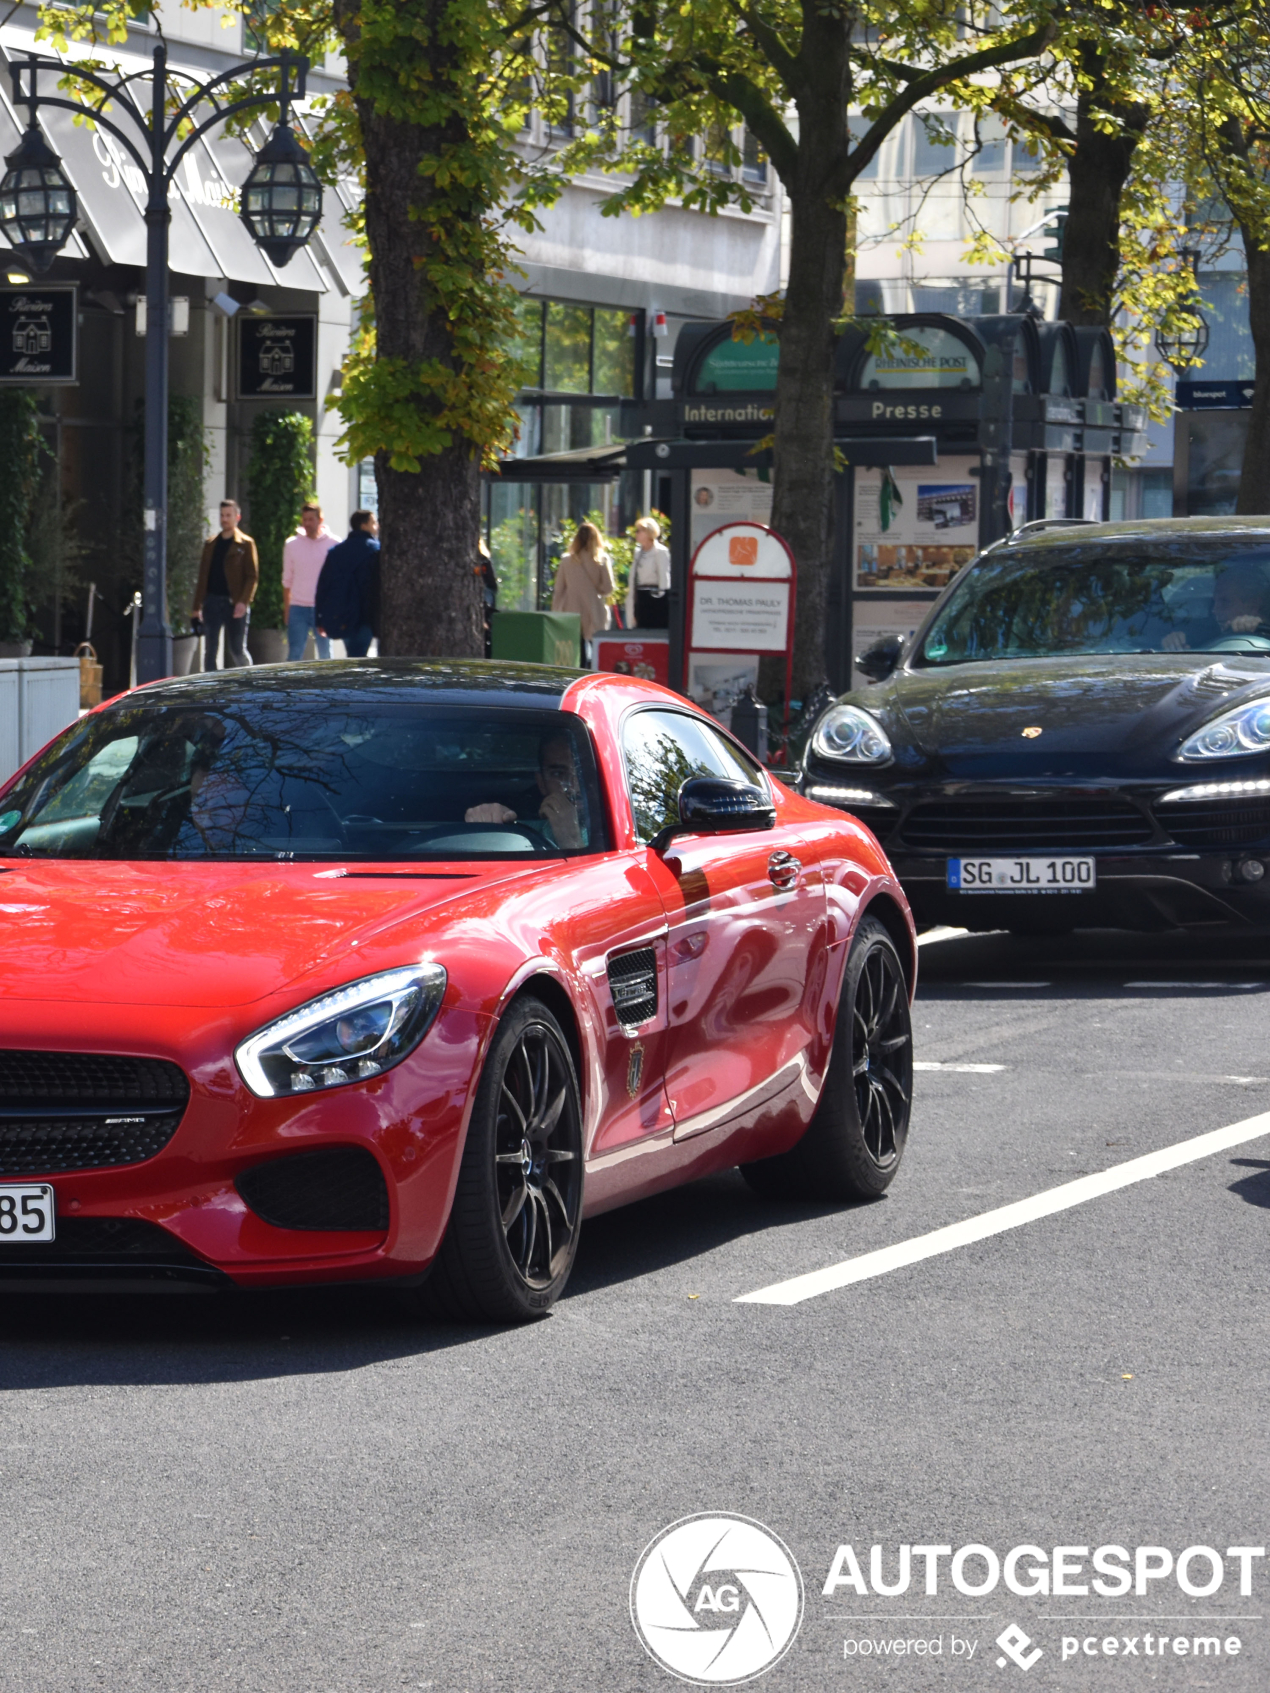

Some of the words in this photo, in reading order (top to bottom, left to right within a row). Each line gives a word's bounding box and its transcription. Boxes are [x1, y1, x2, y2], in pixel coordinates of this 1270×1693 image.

[9, 357, 52, 373] Maison
[875, 357, 937, 369] RHEINISCHE
[939, 356, 968, 368] POST
[872, 401, 943, 419] Presse
[717, 598, 753, 607] THOMAS
[962, 862, 993, 884] SG
[1010, 862, 1040, 884] JL
[1046, 861, 1091, 883] 100
